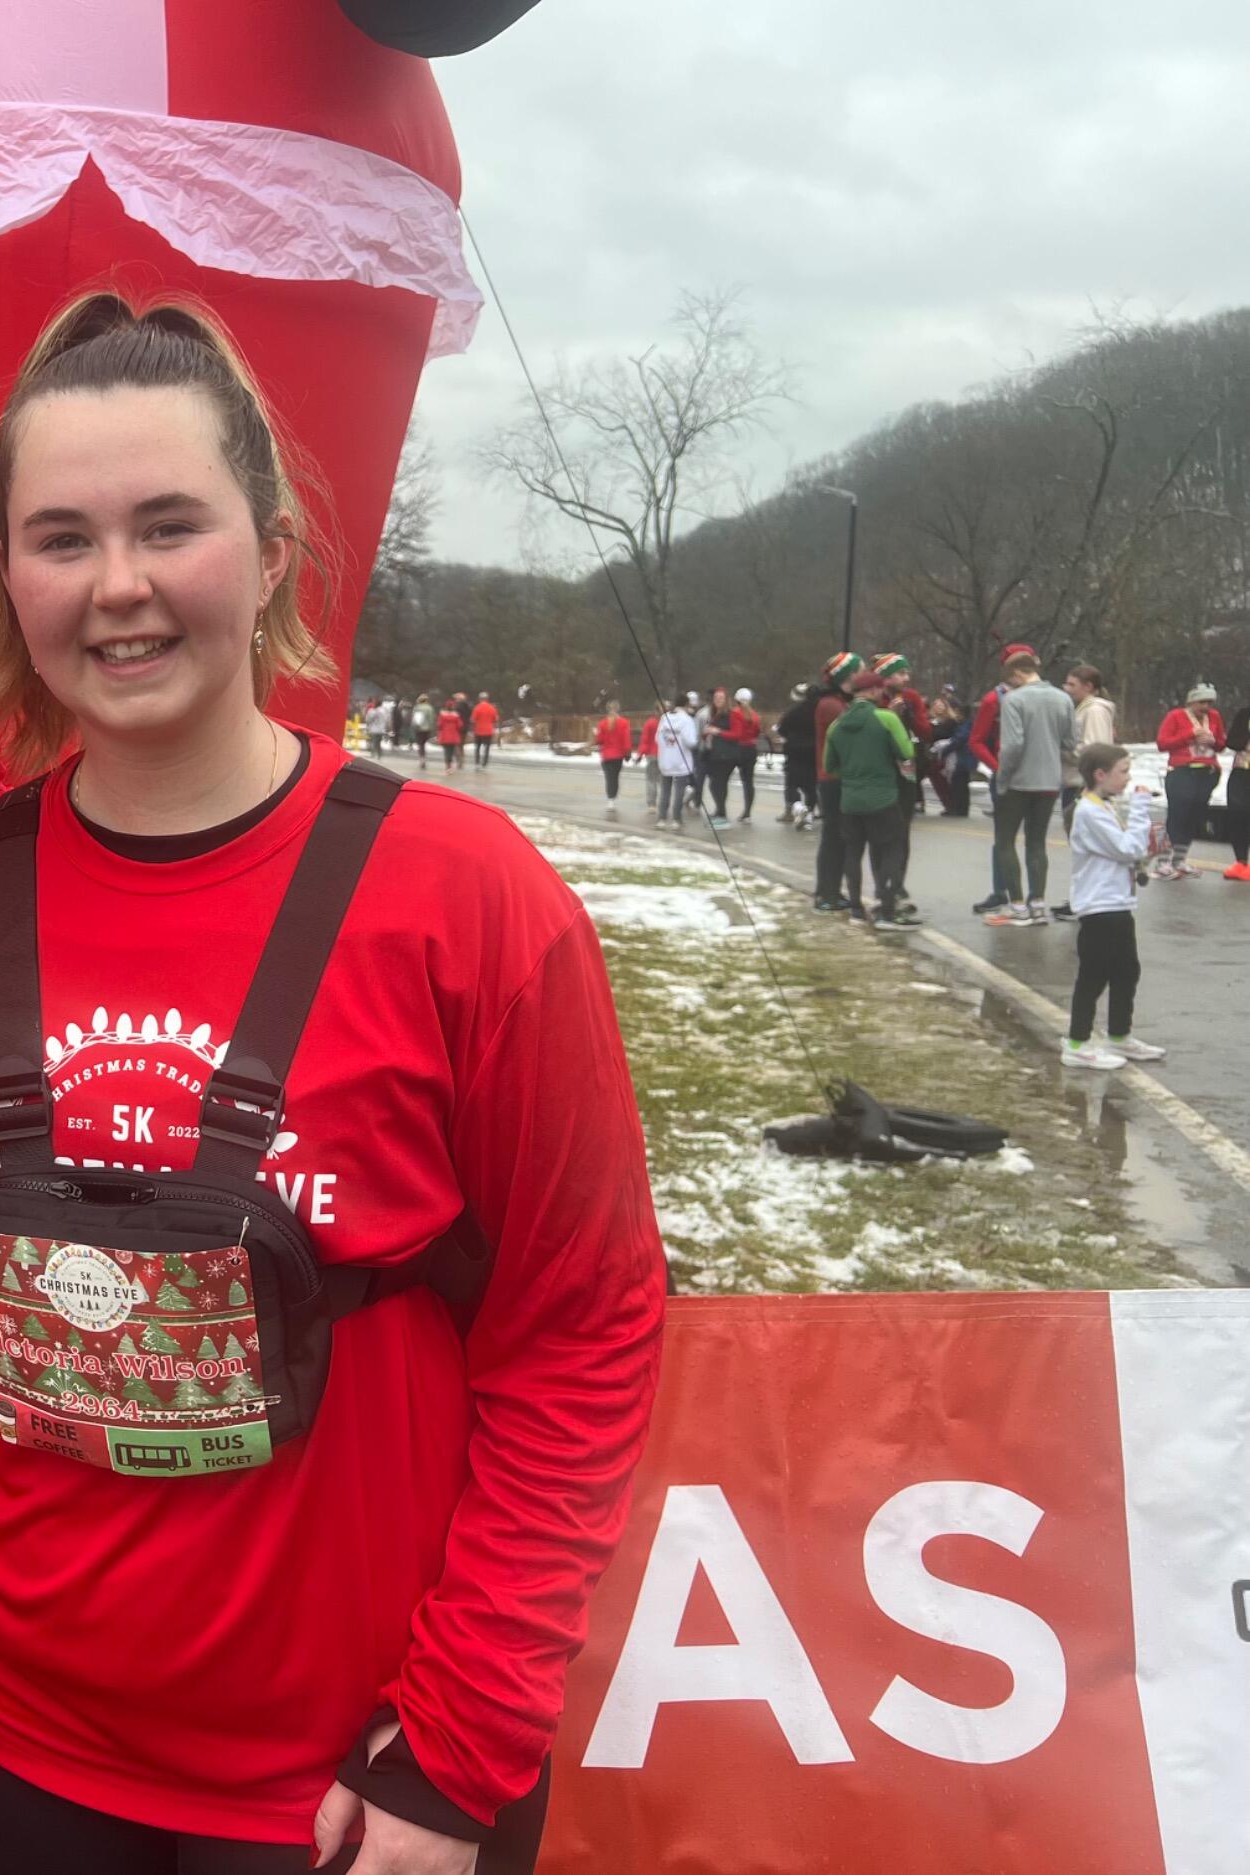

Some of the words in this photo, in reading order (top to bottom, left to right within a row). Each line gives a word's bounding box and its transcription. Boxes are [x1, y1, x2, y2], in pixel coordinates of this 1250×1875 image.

[52, 1059, 146, 1102] HRISTMAS
[156, 1062, 203, 1100] TRAD
[67, 1117, 96, 1130] EST.
[112, 1104, 155, 1143] 5K
[168, 1126, 200, 1138] 2022
[254, 1171, 337, 1224] VE
[40, 1278, 108, 1298] CHRISTMAS
[114, 1287, 138, 1300] EVE
[80, 1271, 91, 1280] 5K
[112, 1352, 247, 1381] Wilson
[61, 1391, 141, 1422] 2964
[31, 1413, 78, 1441] FREE
[33, 1438, 85, 1460] COFFEE
[201, 1434, 244, 1452] BUS
[203, 1454, 253, 1468] TICKET
